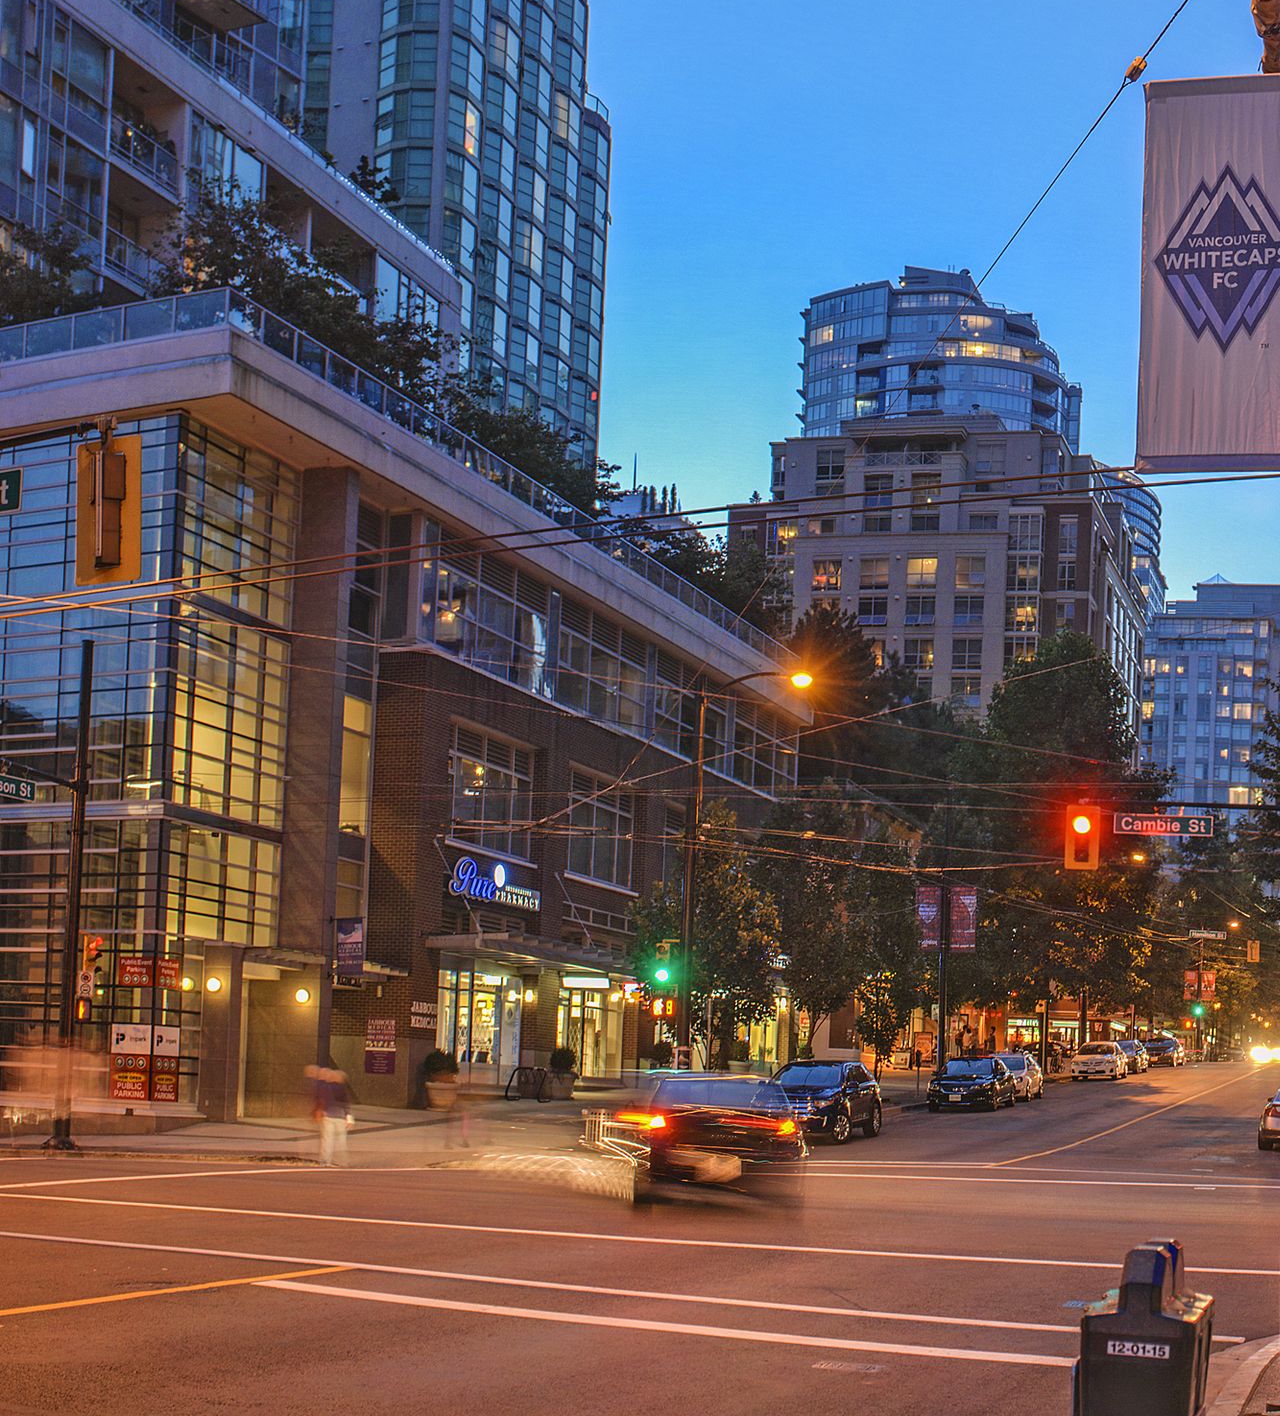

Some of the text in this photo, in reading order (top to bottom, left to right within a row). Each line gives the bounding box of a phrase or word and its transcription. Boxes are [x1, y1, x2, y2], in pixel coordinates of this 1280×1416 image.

[1188, 234, 1267, 248] VANCOUVER
[1213, 271, 1238, 289] FC
[20, 782, 31, 797] St
[1121, 817, 1206, 833] Cambie St
[449, 856, 497, 901] Pure
[495, 890, 540, 910] PHARMACY
[117, 1082, 142, 1090] PUBLIC
[156, 1084, 174, 1092] PUBLIC
[114, 1089, 145, 1099] PARKING
[155, 1092, 175, 1100] PARKING
